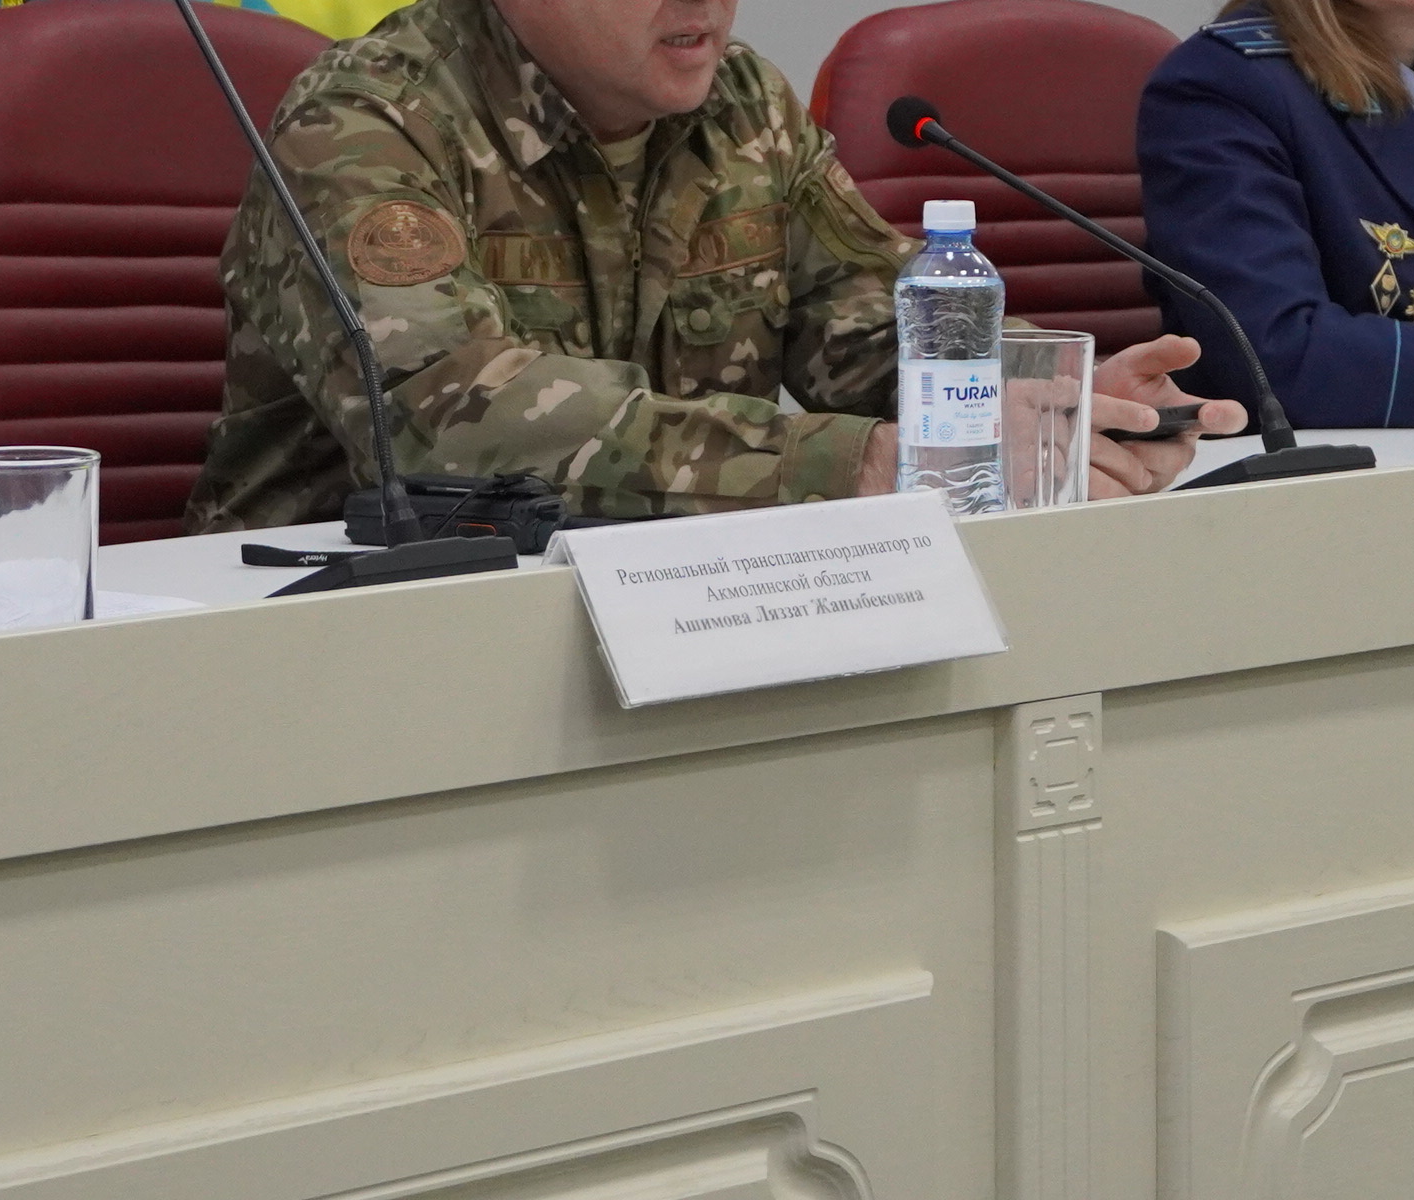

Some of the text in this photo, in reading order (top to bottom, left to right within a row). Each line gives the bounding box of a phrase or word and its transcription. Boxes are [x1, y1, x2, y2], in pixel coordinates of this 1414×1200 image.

[943, 384, 997, 401] TURAN
[922, 414, 930, 439] KMW
[616, 536, 931, 585] Региональный транспланткоординатор по
[708, 570, 871, 602] Акмолинской области
[675, 590, 924, 634] Ашимова Ляззат Жаныбековна
